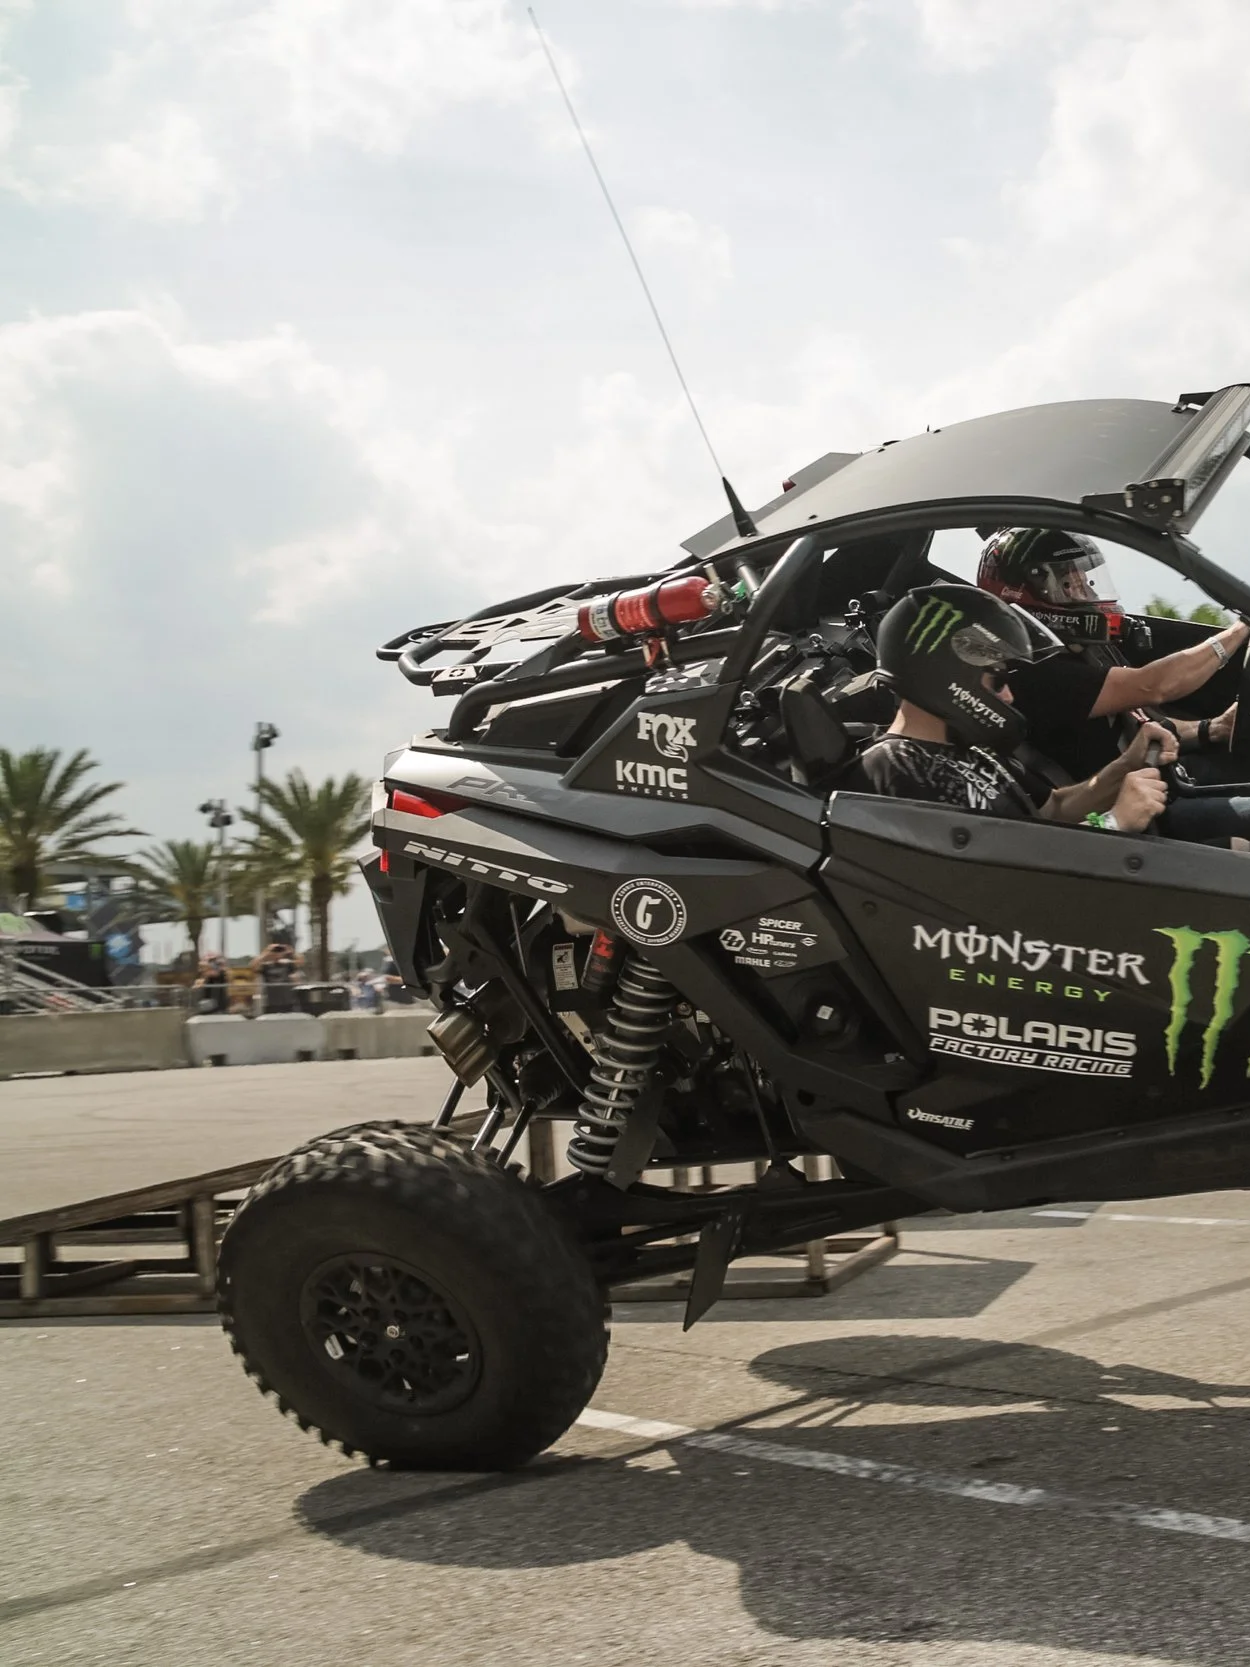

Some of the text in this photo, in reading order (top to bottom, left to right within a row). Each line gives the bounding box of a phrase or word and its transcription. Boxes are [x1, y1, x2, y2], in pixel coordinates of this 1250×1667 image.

[948, 683, 1006, 728] MONSTER
[637, 712, 697, 762] FOX
[616, 760, 688, 790] KMC
[617, 785, 688, 799] WHEELS
[403, 841, 569, 894] NITTO
[758, 918, 803, 930] SPICER
[735, 956, 771, 967] MAHLE
[912, 925, 1151, 985] MONSTER
[949, 969, 1111, 1001] ENERGY
[929, 1007, 1137, 1056] POLARIS
[929, 1037, 1132, 1075] FACTORY RACING
[906, 1107, 975, 1128] VERSATILE
